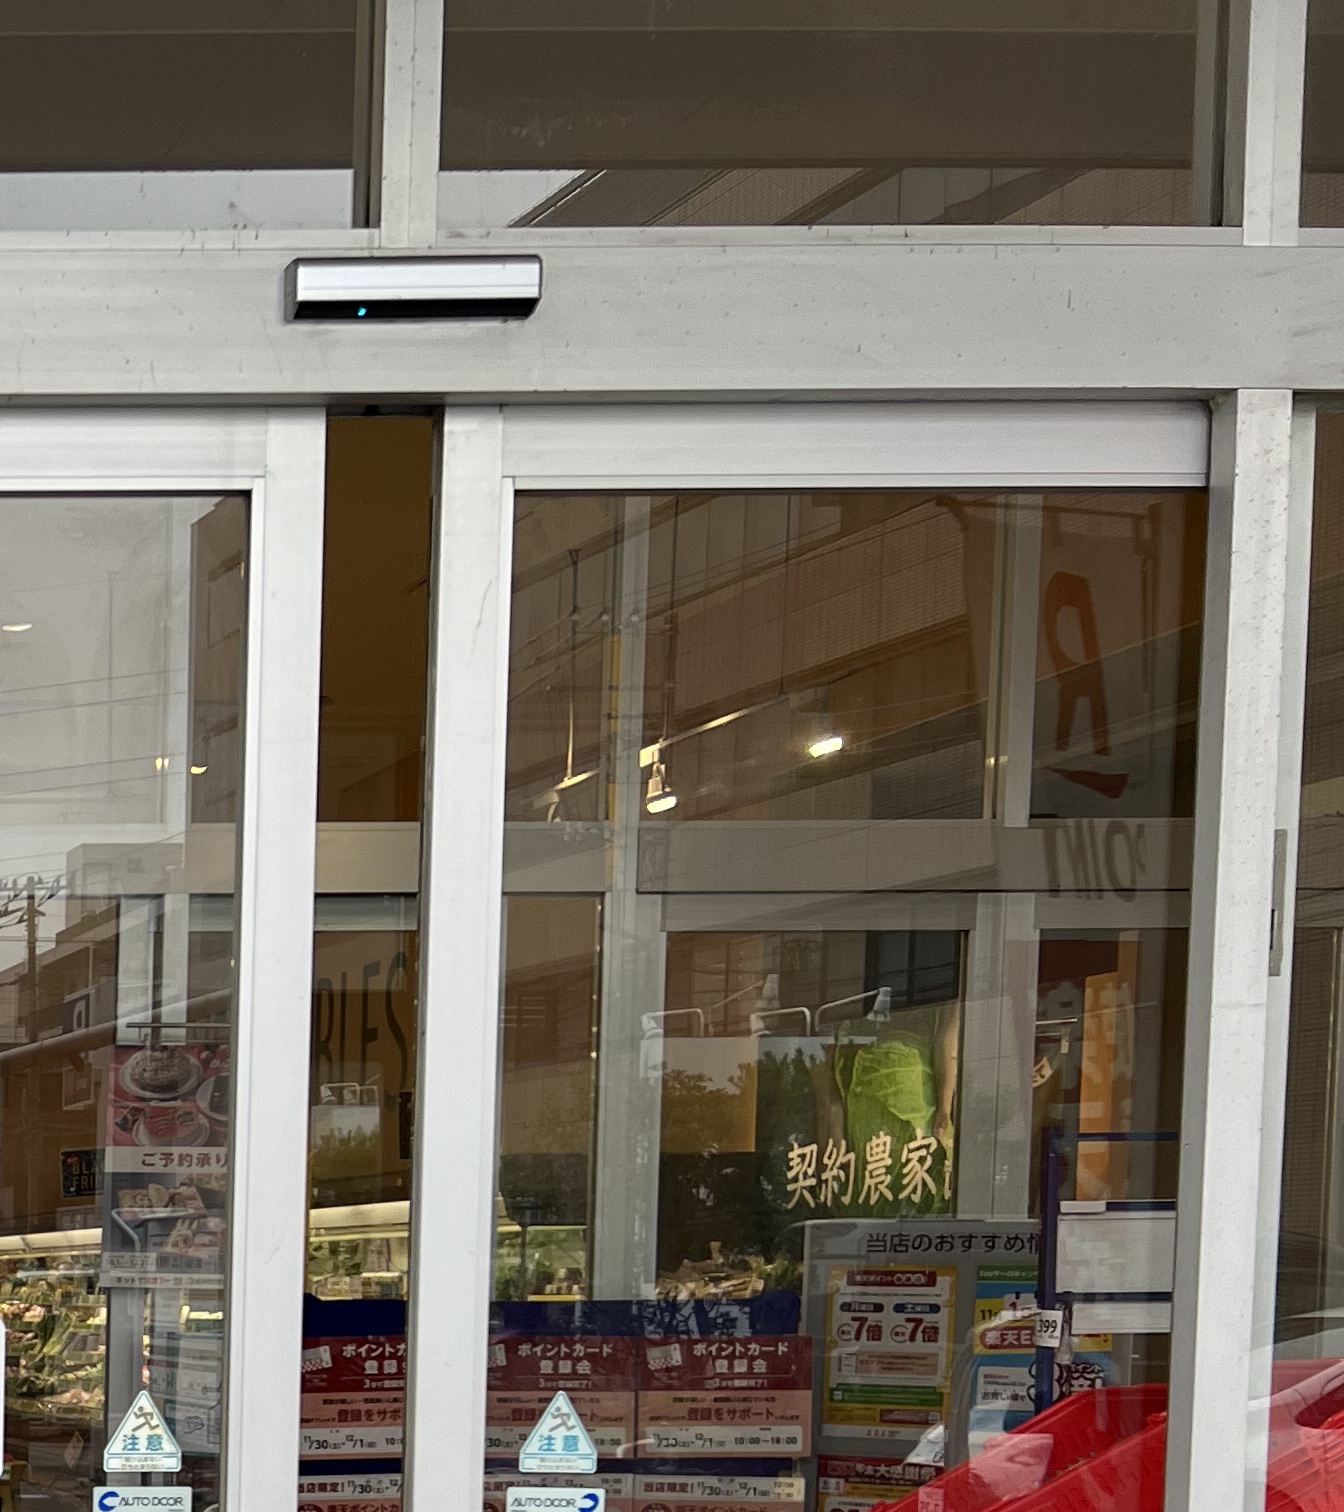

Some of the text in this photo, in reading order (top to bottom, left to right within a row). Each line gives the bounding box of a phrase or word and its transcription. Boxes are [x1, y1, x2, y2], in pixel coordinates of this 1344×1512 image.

[1037, 1319, 1058, 1333] 399
[518, 1342, 613, 1358] ポイントカード
[693, 1342, 789, 1356] ポイントカード
[122, 1434, 163, 1451] 注意
